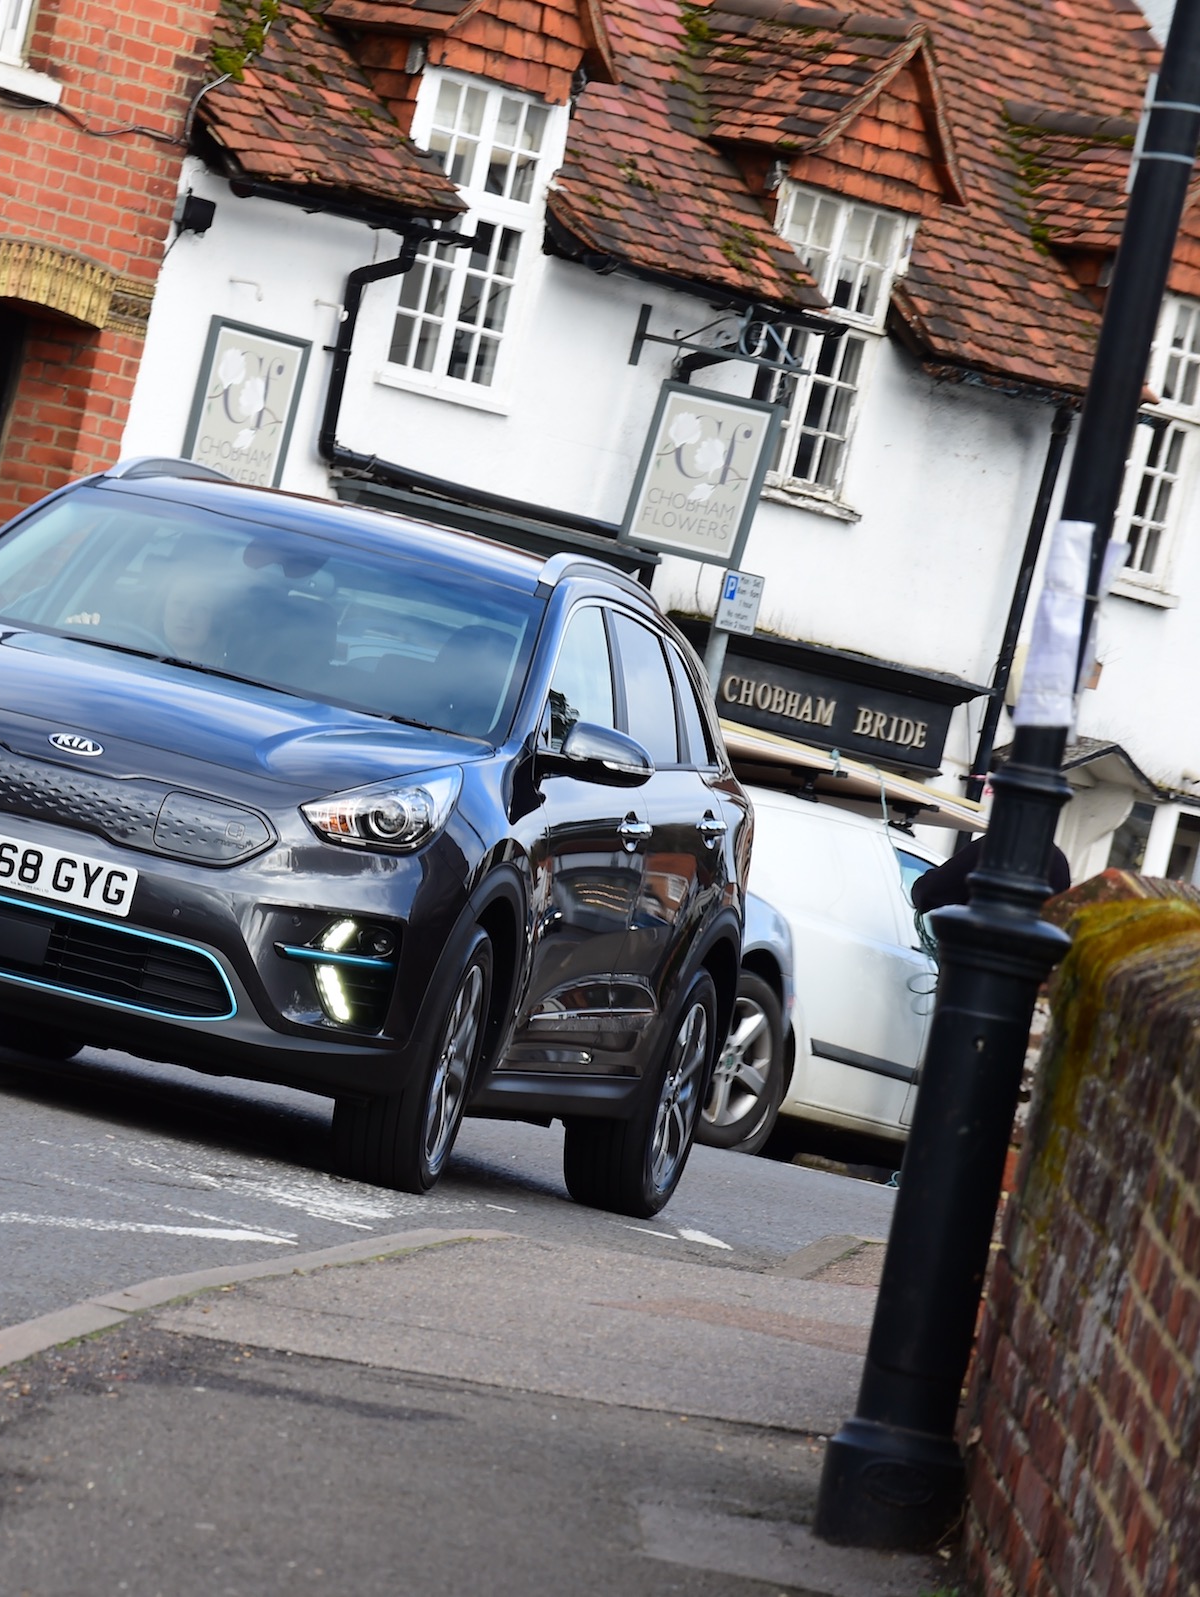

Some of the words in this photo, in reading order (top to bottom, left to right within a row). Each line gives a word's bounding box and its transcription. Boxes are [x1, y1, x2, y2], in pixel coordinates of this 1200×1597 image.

[200, 436, 272, 467] CHOBHAM
[647, 487, 736, 521] CHOBHAM
[641, 506, 730, 540] FLOWERS
[722, 675, 837, 727] CHOBHAM
[852, 706, 929, 749] BRIDE
[56, 733, 94, 752] KIA
[52, 857, 128, 906] GYG
